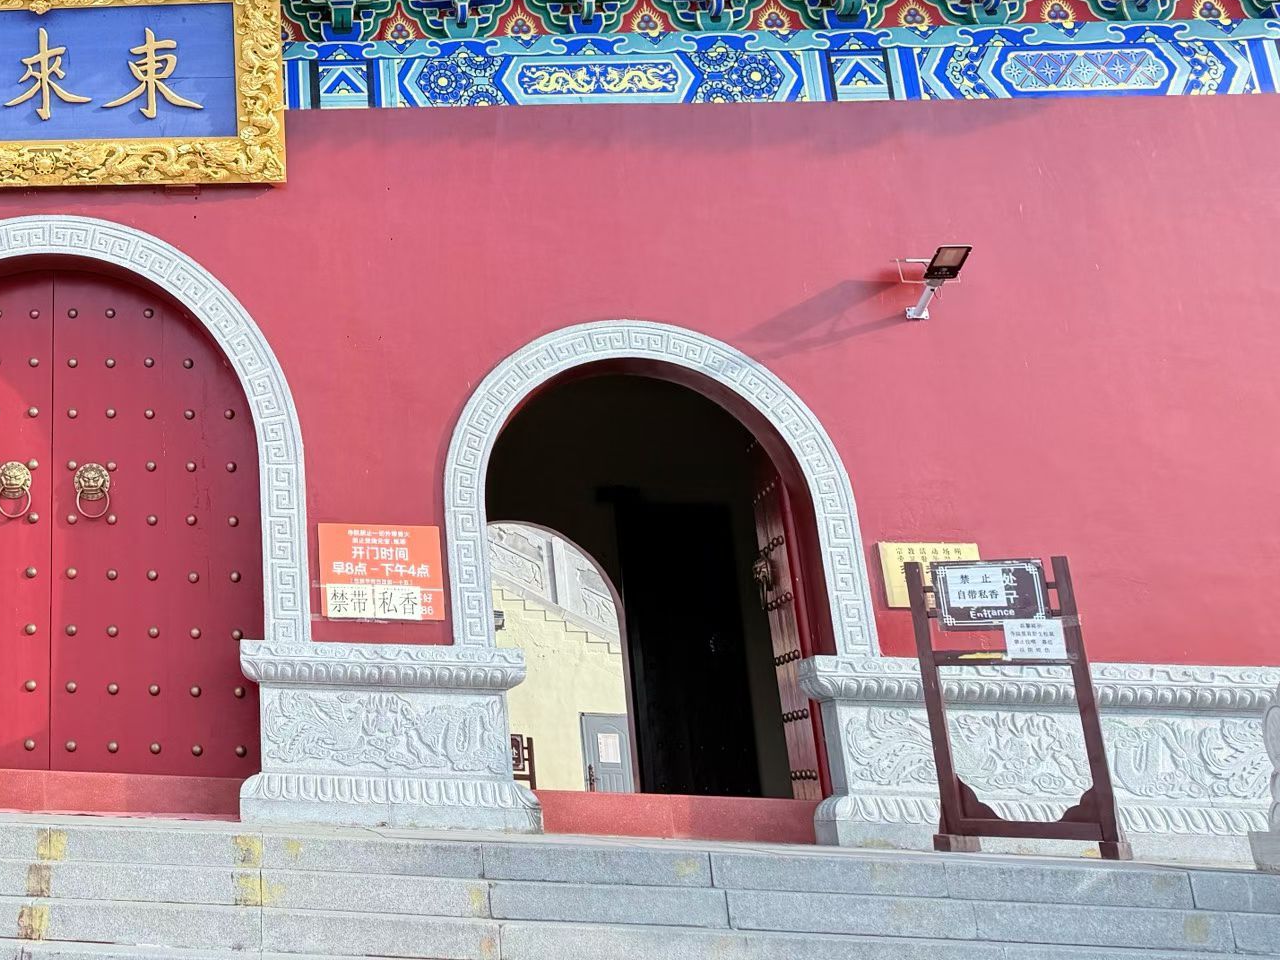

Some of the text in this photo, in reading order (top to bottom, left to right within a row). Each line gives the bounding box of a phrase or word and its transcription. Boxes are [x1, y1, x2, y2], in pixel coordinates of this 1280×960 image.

[352, 546, 408, 561] 开门时间
[960, 574, 991, 584] 禁止
[957, 590, 999, 600] 自带私香
[330, 589, 417, 615] 禁带私香
[970, 608, 1015, 619] Entrance
